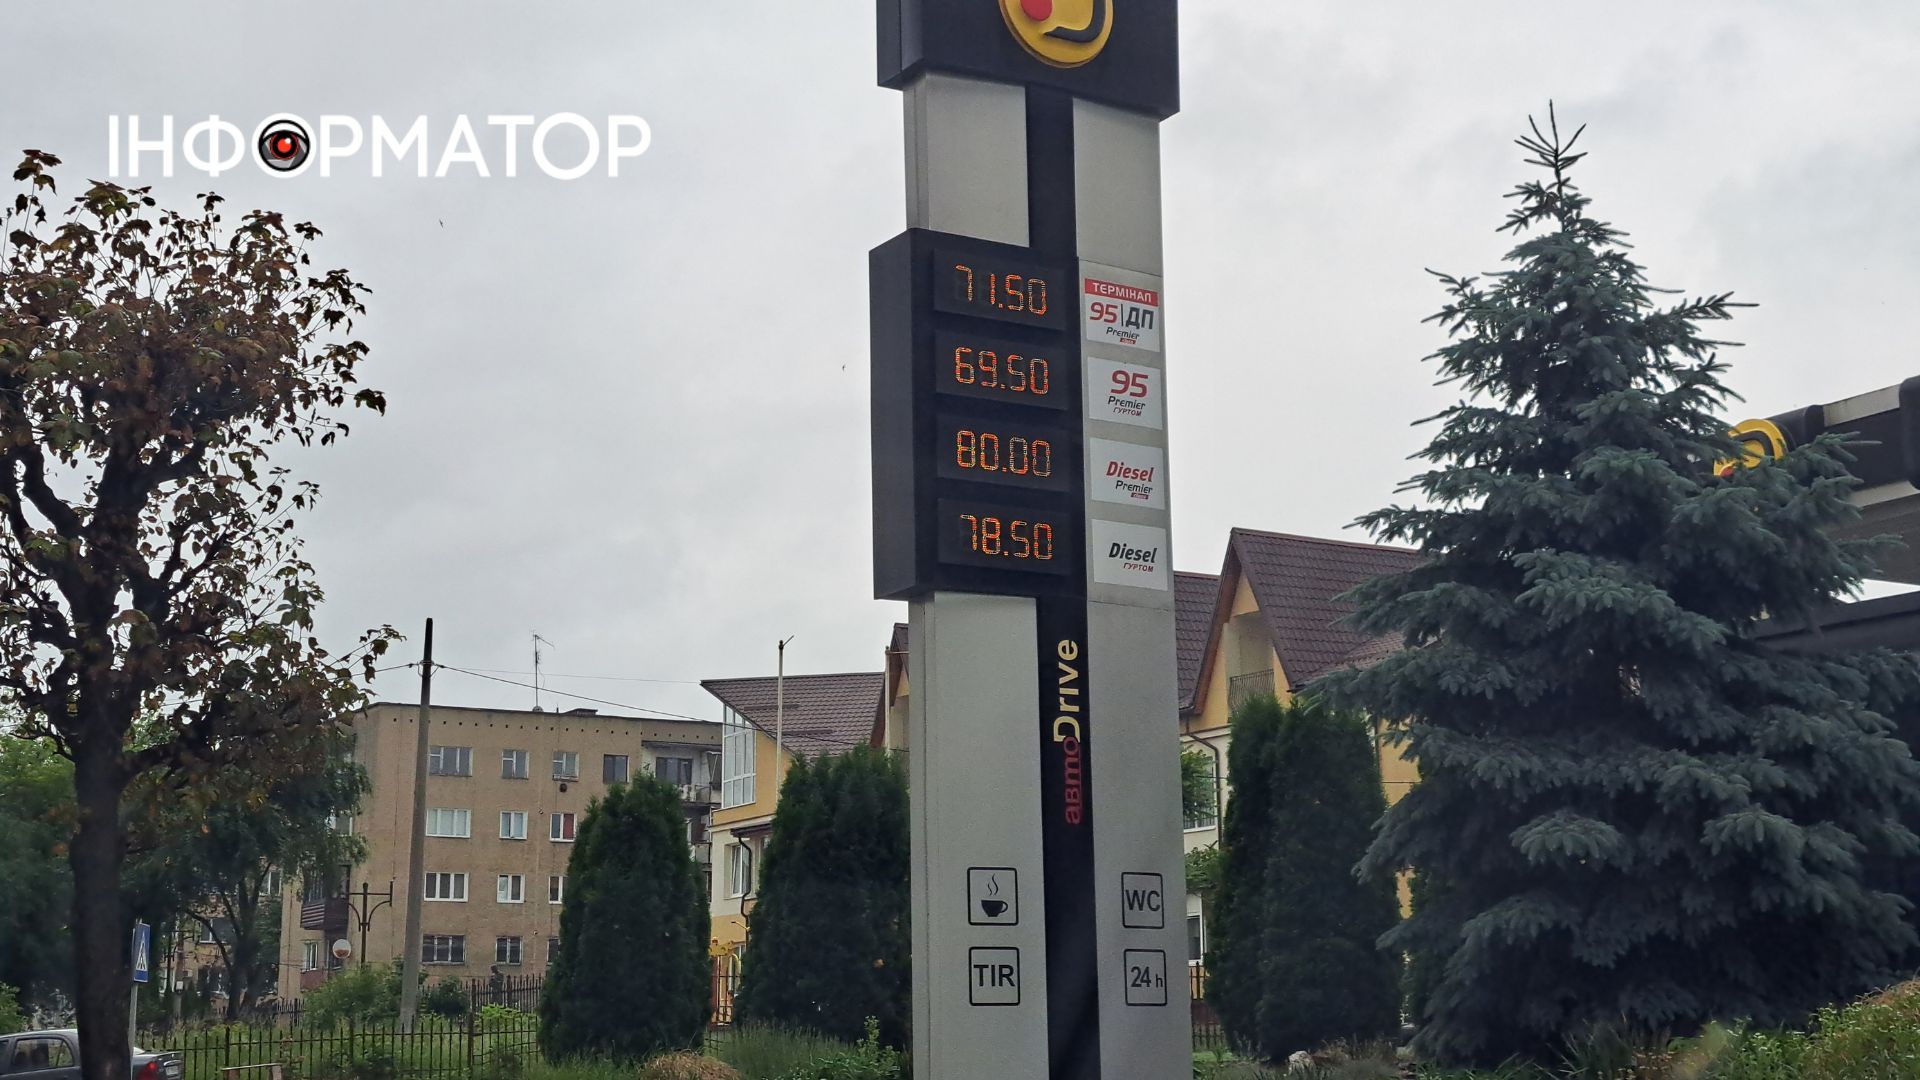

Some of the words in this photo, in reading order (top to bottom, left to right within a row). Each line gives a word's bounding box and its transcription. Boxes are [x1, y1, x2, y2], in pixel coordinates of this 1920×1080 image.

[955, 264, 1048, 315] 71.50
[1105, 326, 1140, 340] Premier
[955, 346, 1049, 395] 69.50
[1110, 369, 1149, 398] 95
[1107, 395, 1147, 410] Premier
[956, 430, 1051, 477] 80.00
[1105, 460, 1155, 483] Diesel
[1115, 480, 1154, 494] Premier
[960, 513, 1053, 560] 78.50
[1108, 541, 1158, 564] Diesel
[1053, 639, 1081, 743] Drive
[1125, 889, 1161, 912] WC
[973, 964, 1016, 988] TIR
[1130, 966, 1152, 989] 24
[1155, 973, 1164, 989] h
